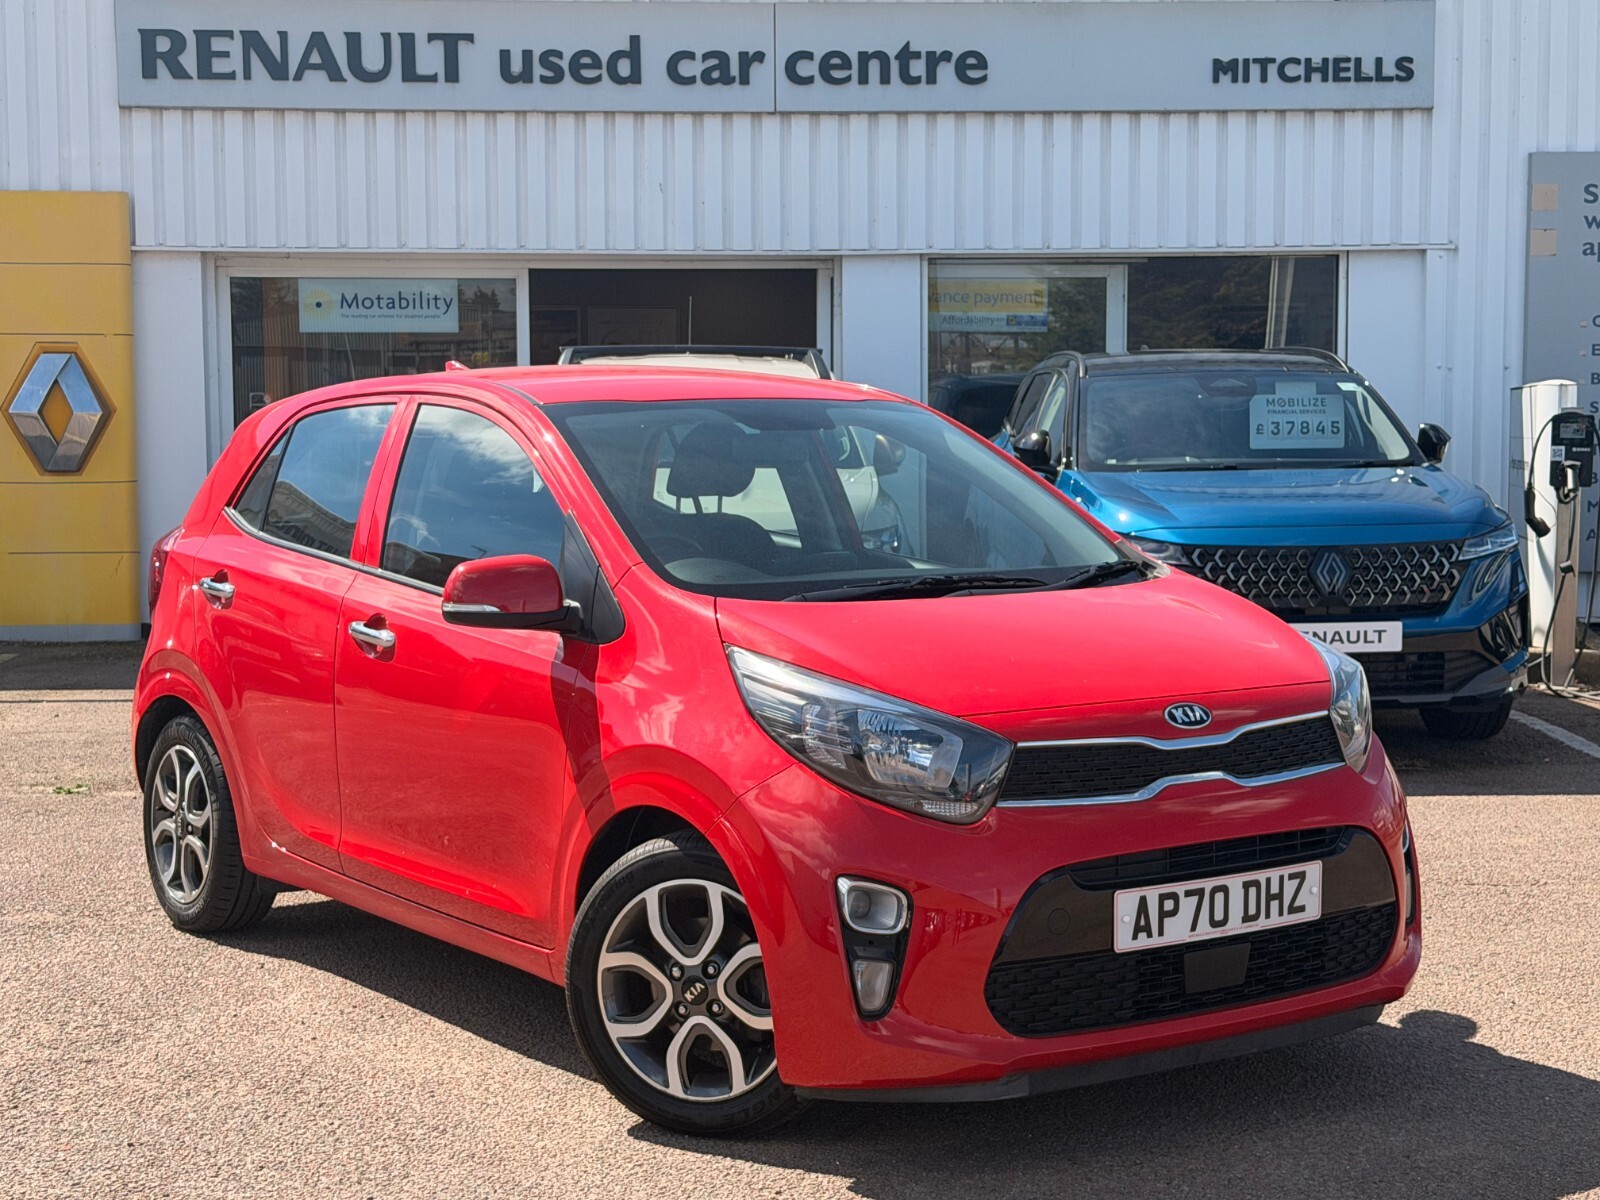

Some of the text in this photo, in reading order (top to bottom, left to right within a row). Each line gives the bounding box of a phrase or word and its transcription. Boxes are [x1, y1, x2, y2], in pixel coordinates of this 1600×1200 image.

[137, 28, 989, 87] RENAULT used car centre
[1212, 56, 1415, 84] MITCHELLS
[340, 290, 454, 316] Motability
[940, 314, 995, 327] Affordability
[1302, 629, 1388, 645] NAULT
[1170, 705, 1208, 724] KIA
[1131, 870, 1307, 941] AP70 DHZ
[684, 981, 705, 1002] KIA
